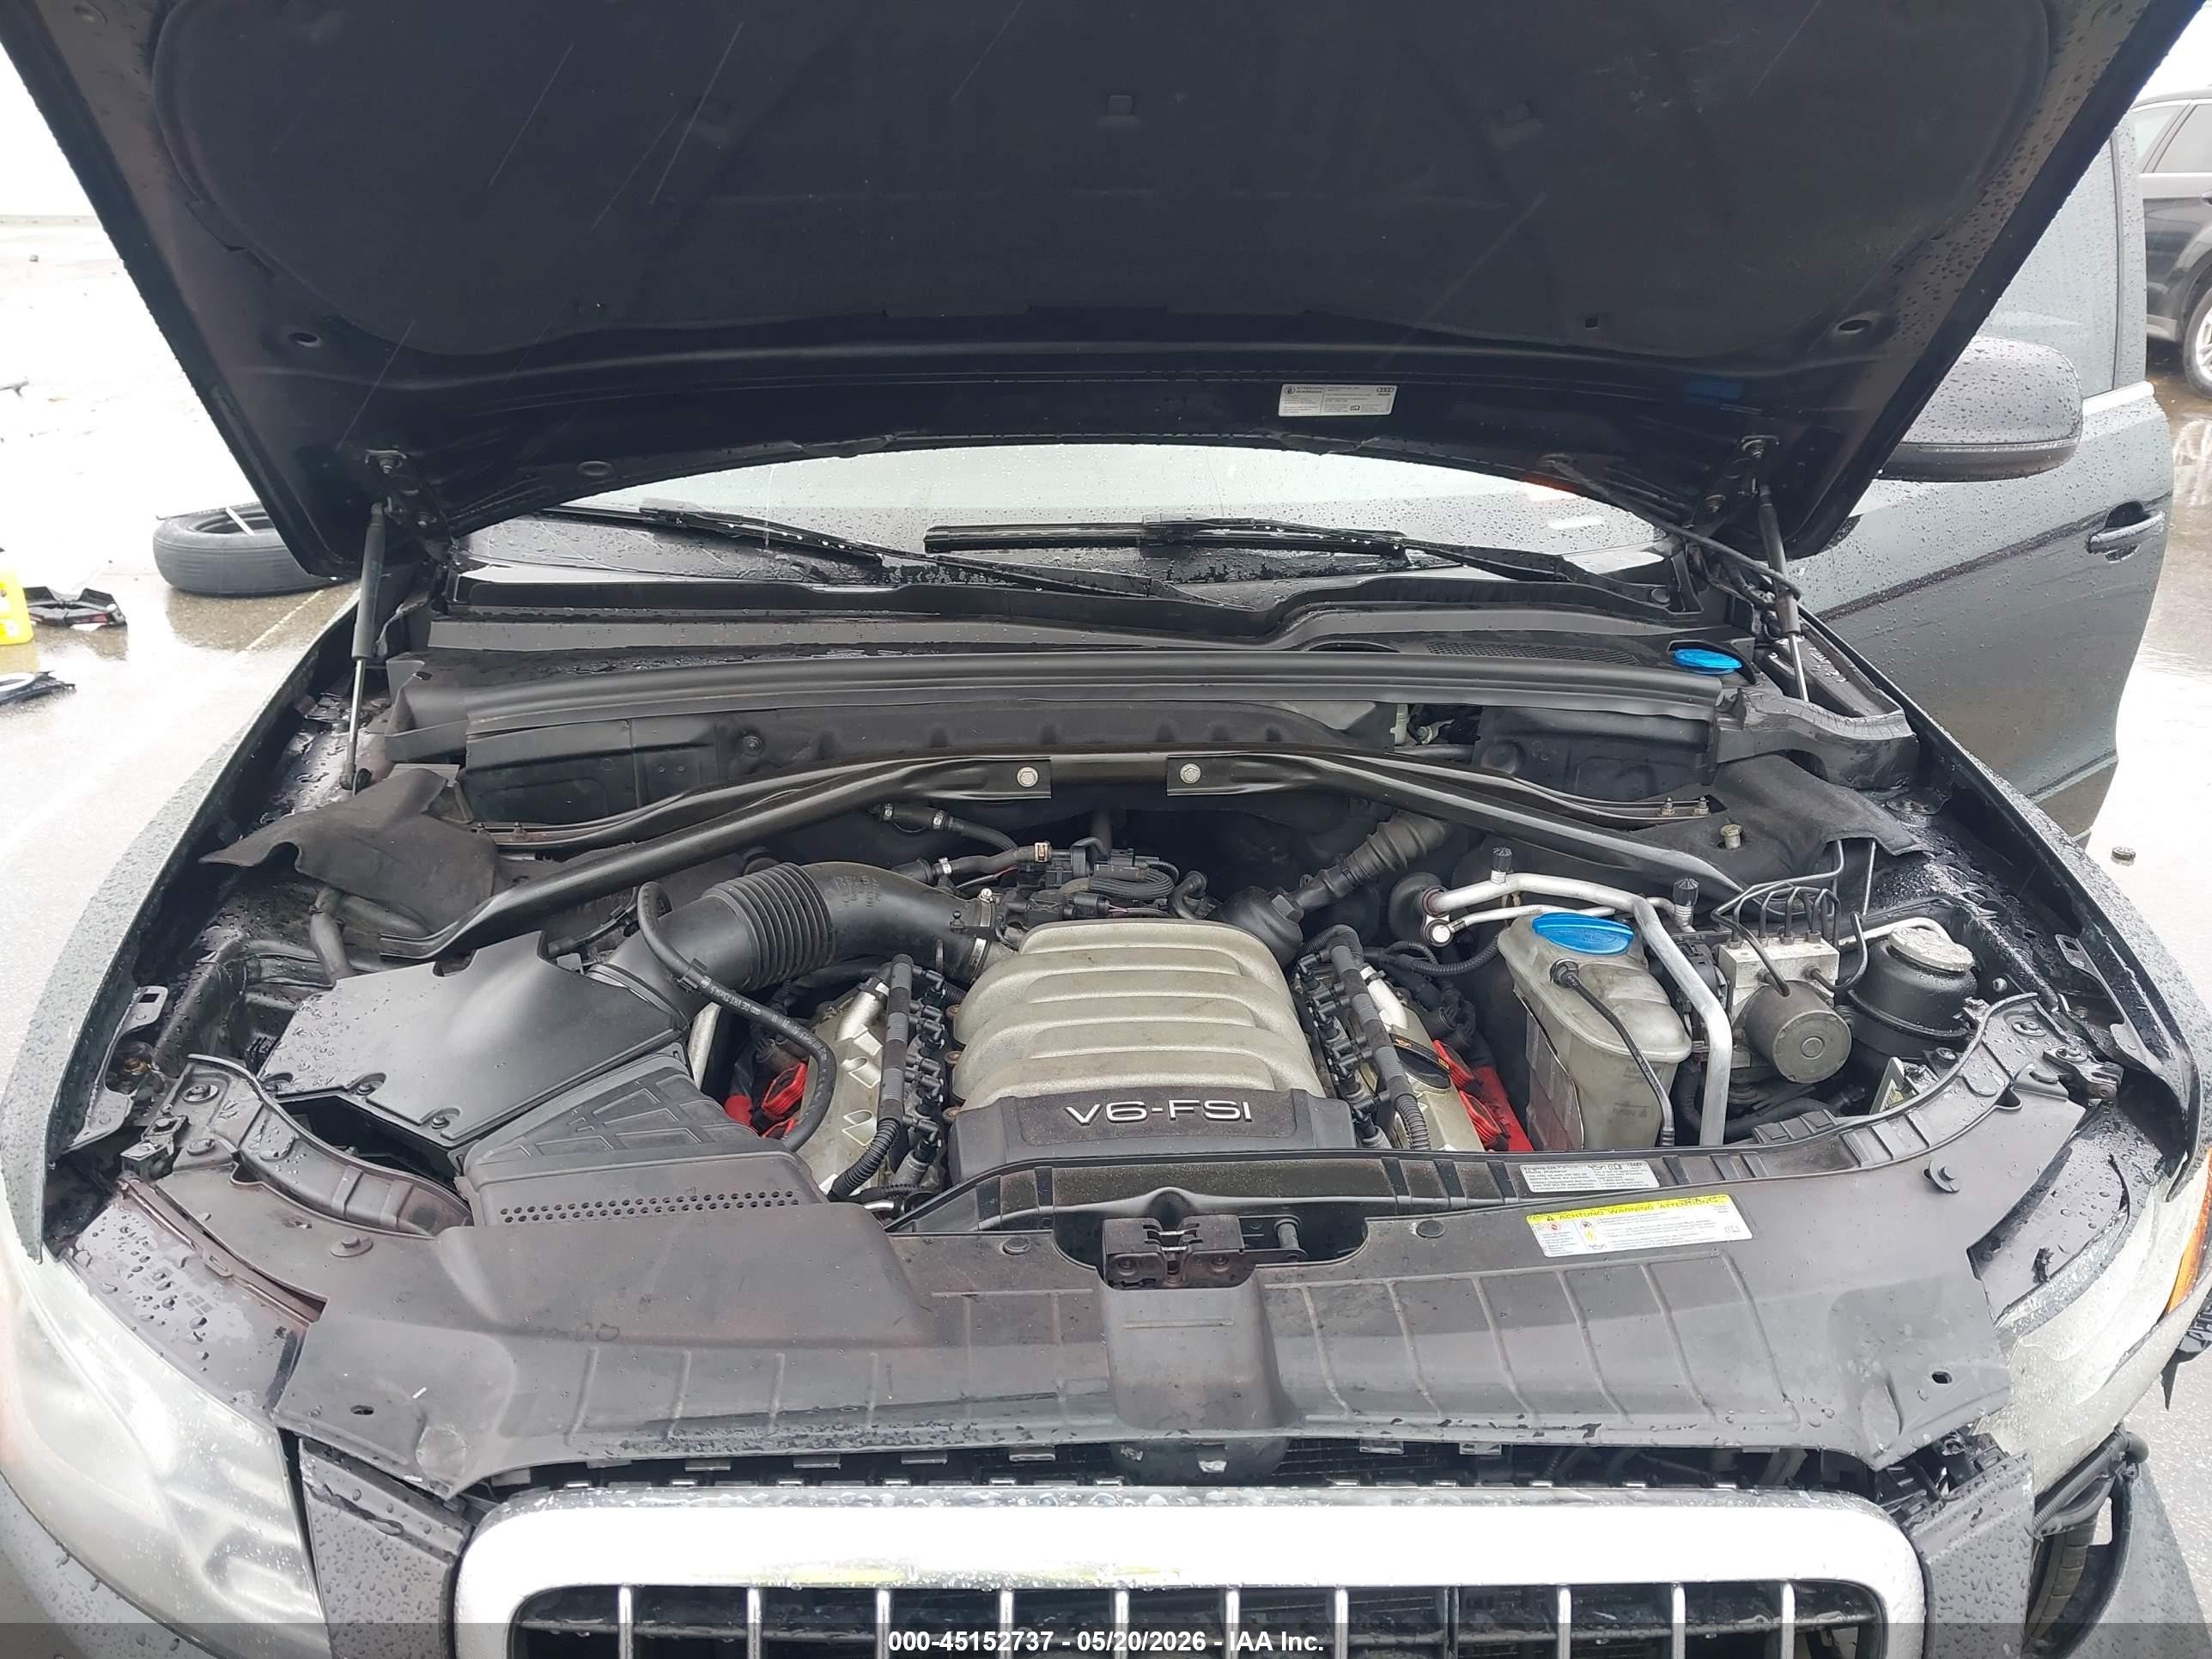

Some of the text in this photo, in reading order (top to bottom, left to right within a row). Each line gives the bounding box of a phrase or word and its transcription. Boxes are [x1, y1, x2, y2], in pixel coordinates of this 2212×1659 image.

[1066, 1099, 1252, 1126] V6-FSI
[1559, 1211, 1604, 1219] ACHTUNG
[1607, 1206, 1654, 1215] WARNING
